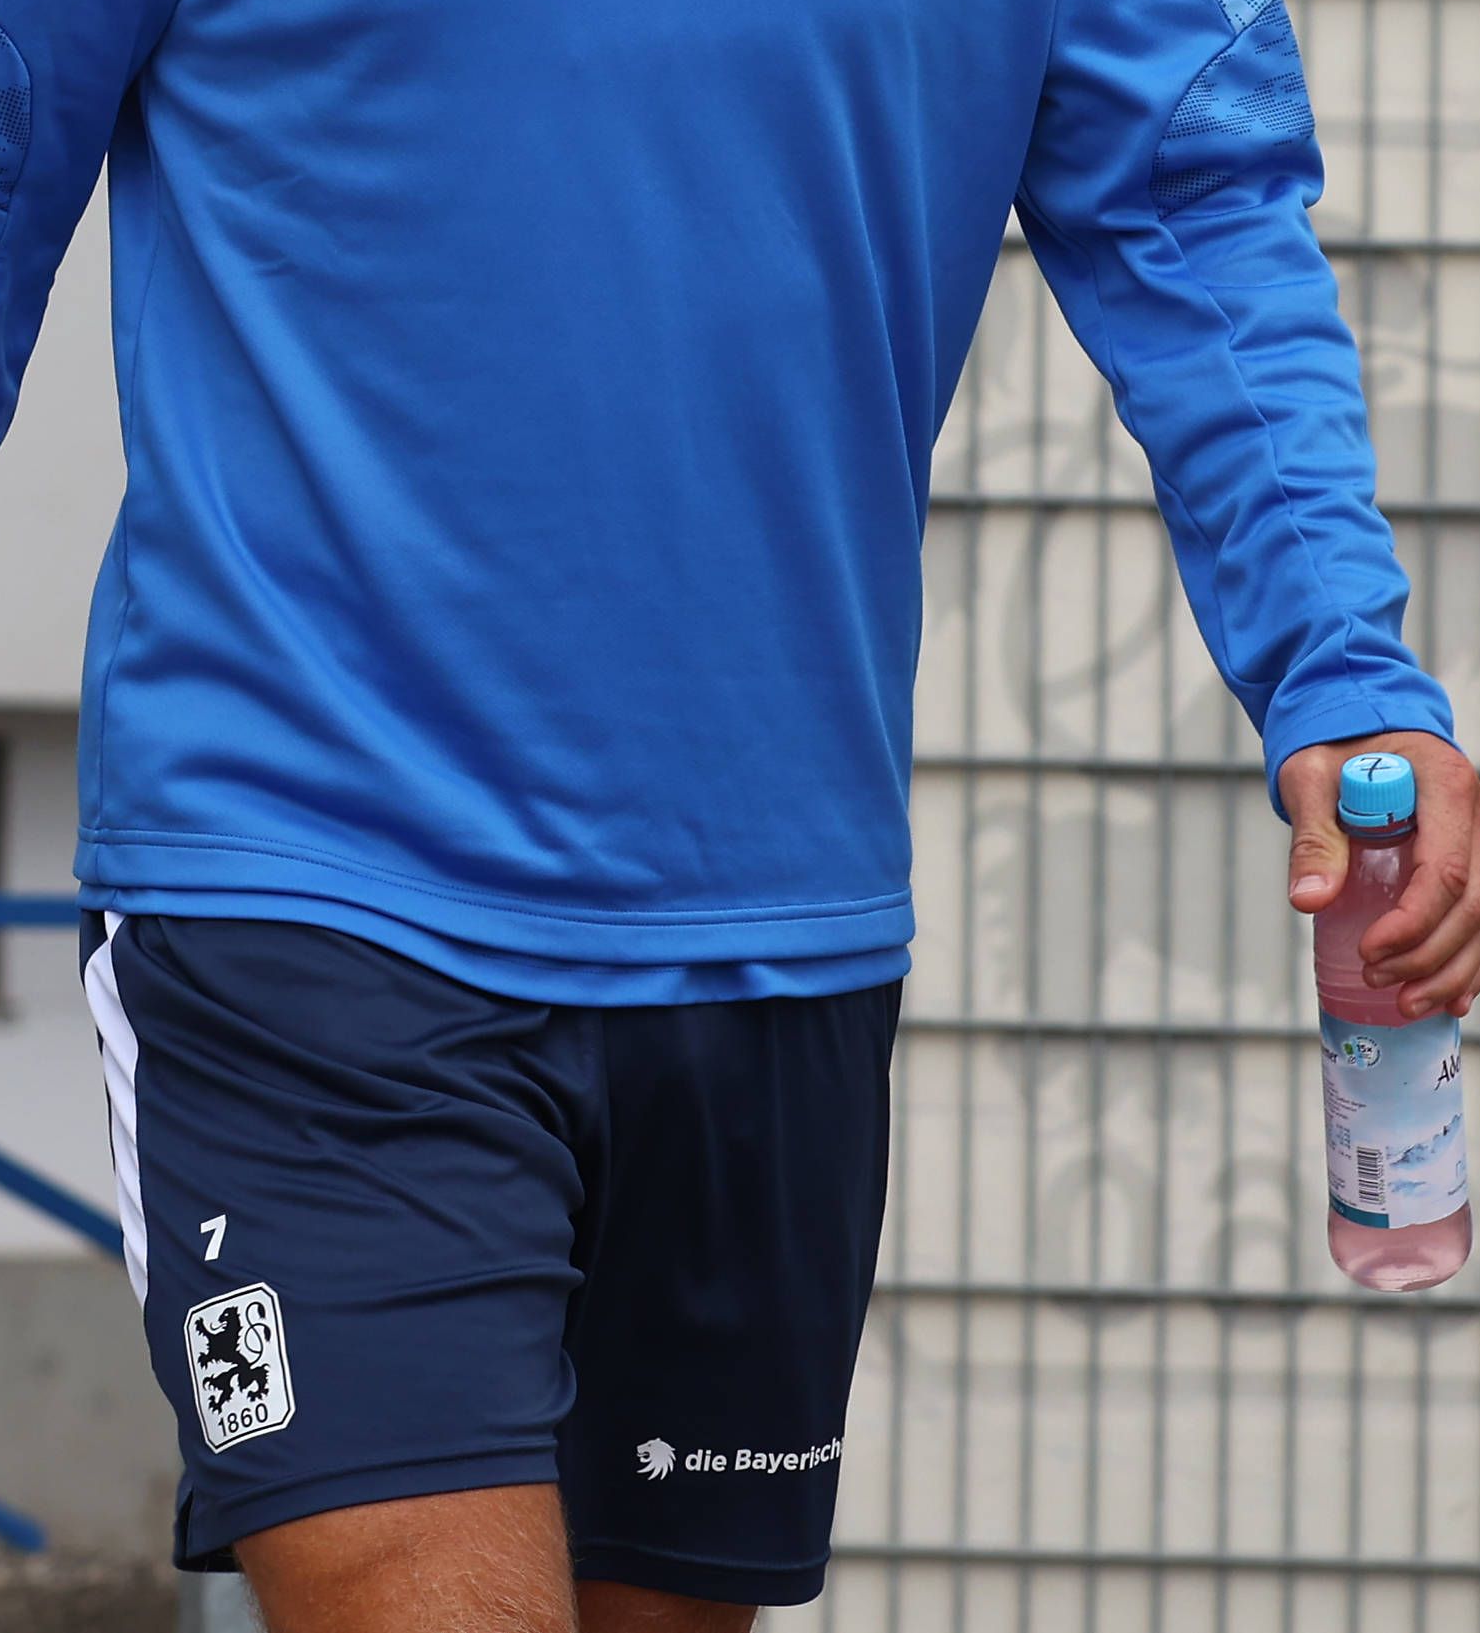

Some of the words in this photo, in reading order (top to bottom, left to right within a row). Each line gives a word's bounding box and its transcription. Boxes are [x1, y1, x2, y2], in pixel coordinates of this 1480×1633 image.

[1360, 757, 1391, 782] 7
[201, 1215, 227, 1261] 7
[218, 1402, 269, 1437] 1860
[685, 1449, 727, 1472] die
